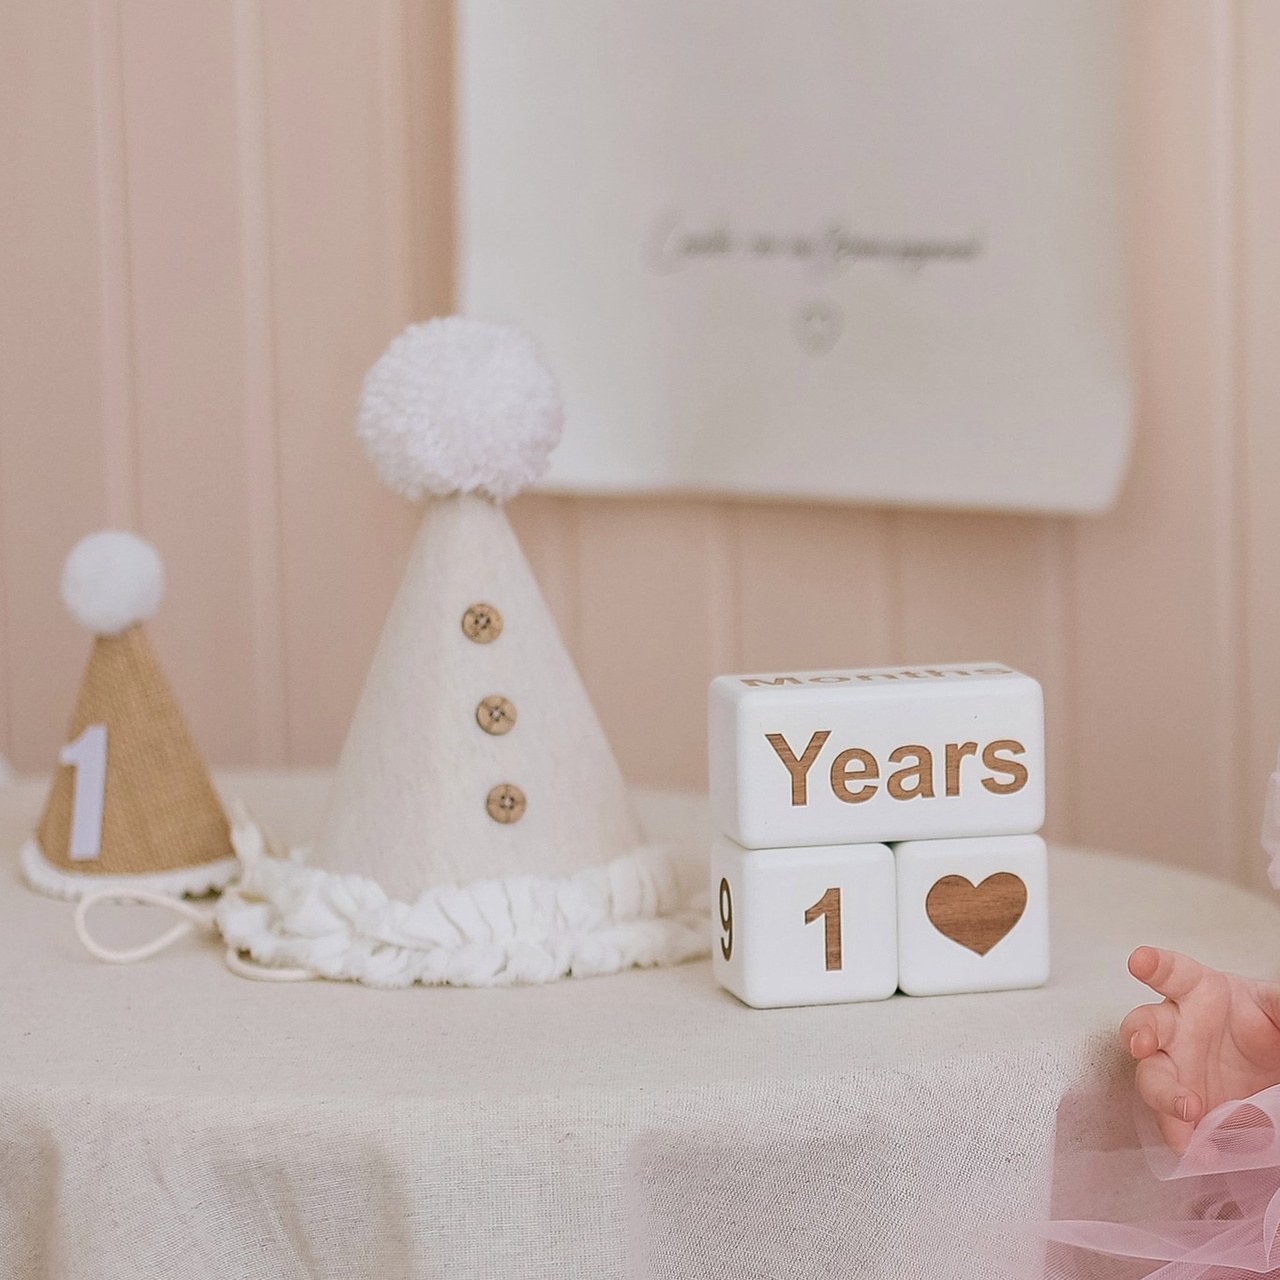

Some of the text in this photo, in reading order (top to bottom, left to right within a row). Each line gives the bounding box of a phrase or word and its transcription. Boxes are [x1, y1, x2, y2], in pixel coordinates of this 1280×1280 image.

[60, 724, 108, 860] 1
[764, 729, 1029, 807] Years
[719, 877, 733, 961] 9
[804, 887, 842, 972] 1
